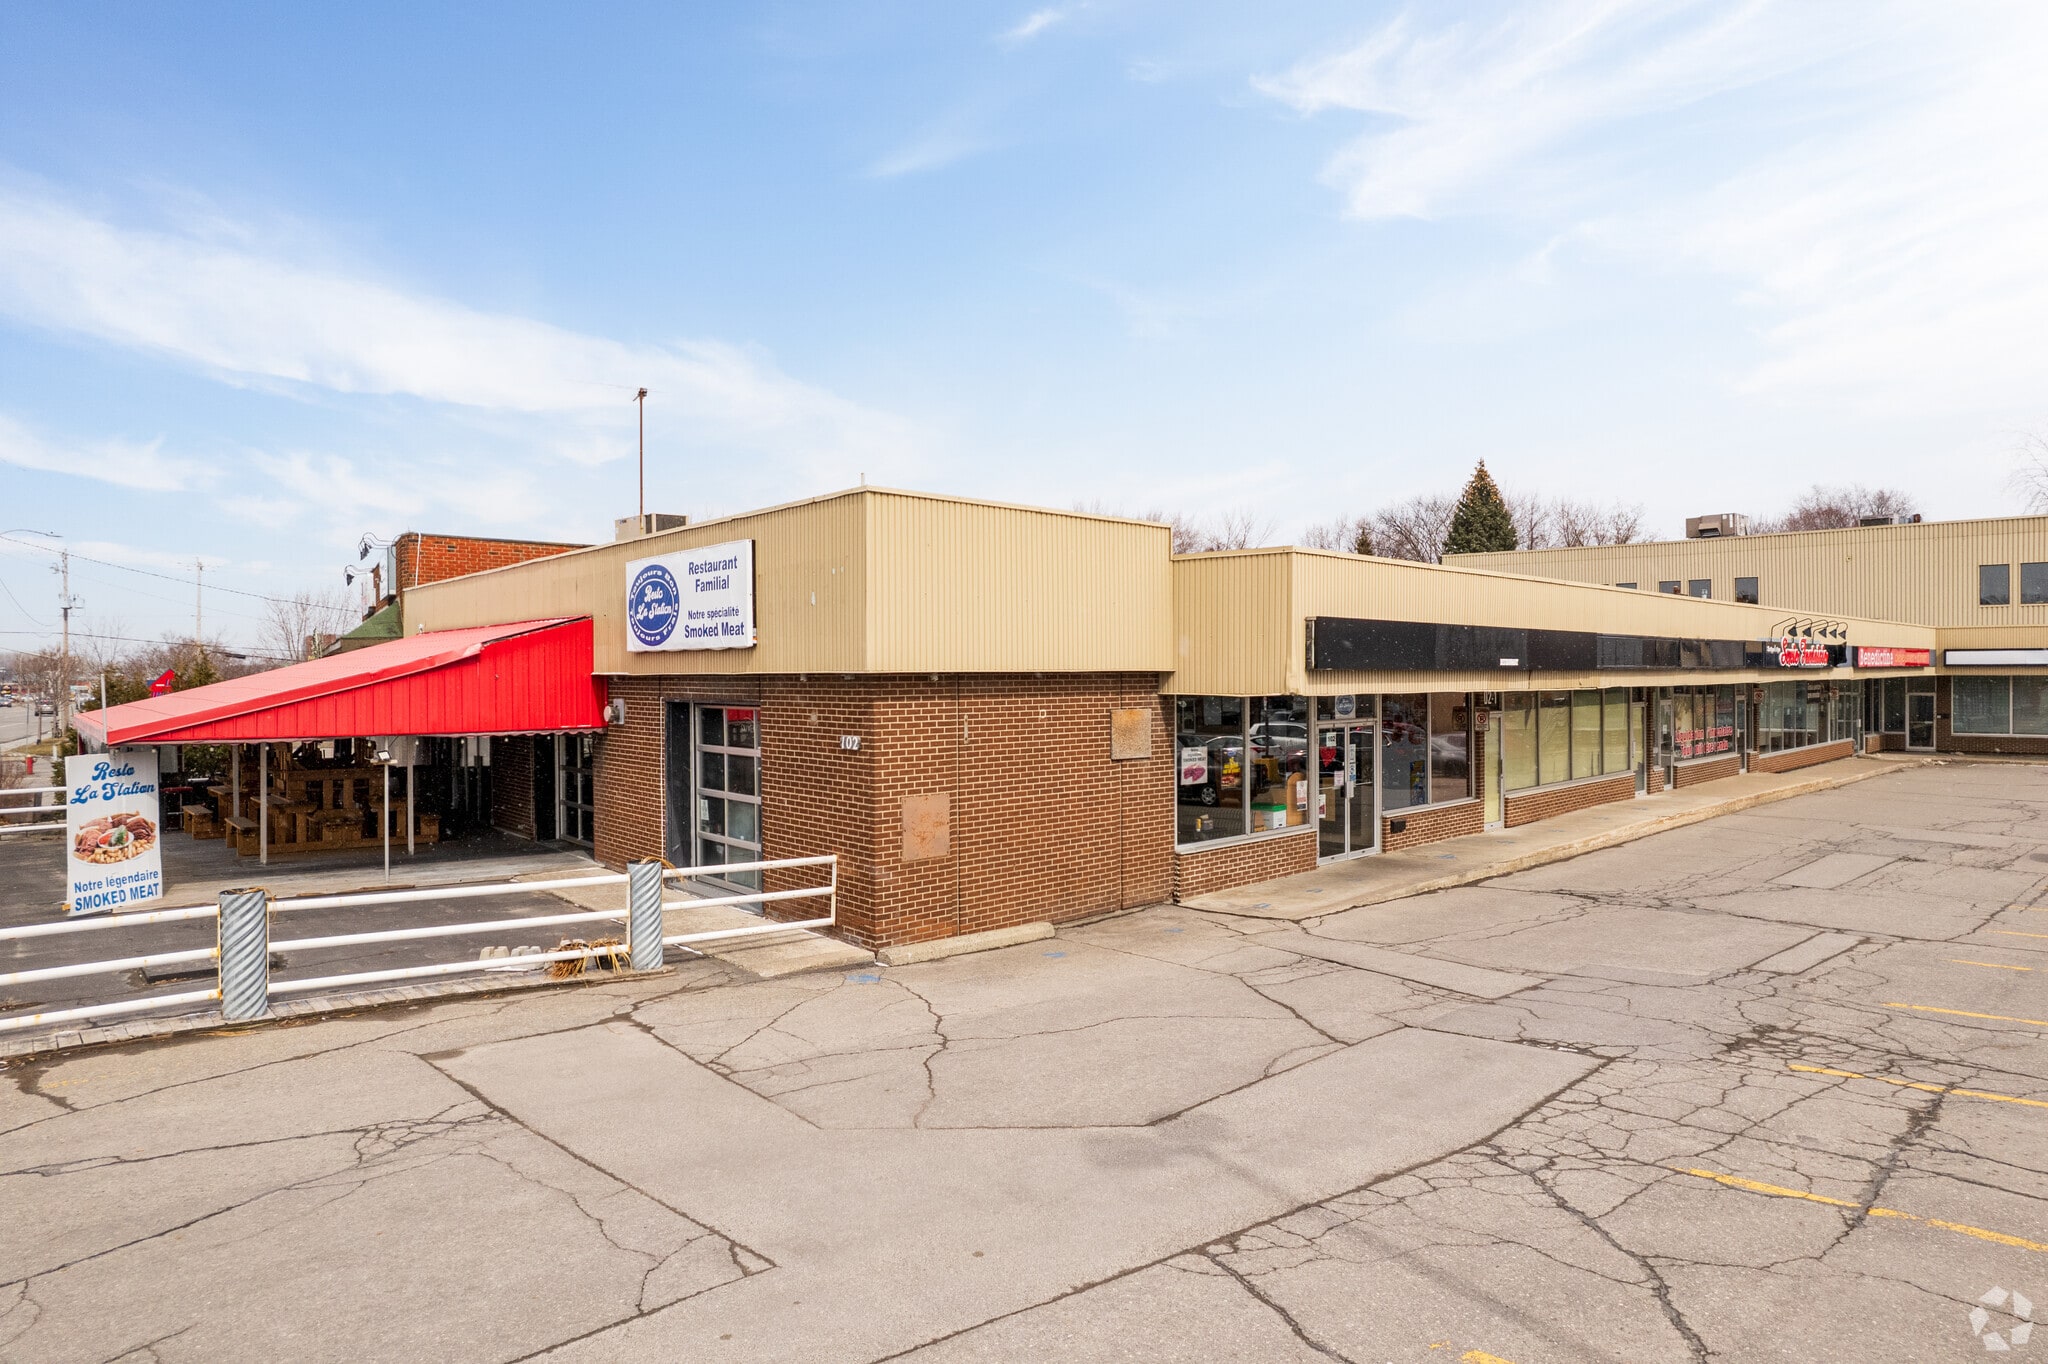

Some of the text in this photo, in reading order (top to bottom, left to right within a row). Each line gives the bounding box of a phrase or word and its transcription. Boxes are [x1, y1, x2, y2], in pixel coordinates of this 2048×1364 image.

[688, 556, 737, 575] Restaurant
[665, 573, 677, 596] Bon
[695, 575, 730, 593] Familial
[648, 602, 673, 619] Station
[687, 605, 740, 620] Notre spécialité
[684, 621, 745, 638] Smoked Meat
[841, 735, 860, 750] 102
[91, 761, 135, 781] Resto
[70, 781, 155, 804] La Station
[74, 870, 159, 893] Notre légendaire
[75, 882, 160, 911] SMOKED MEAT
